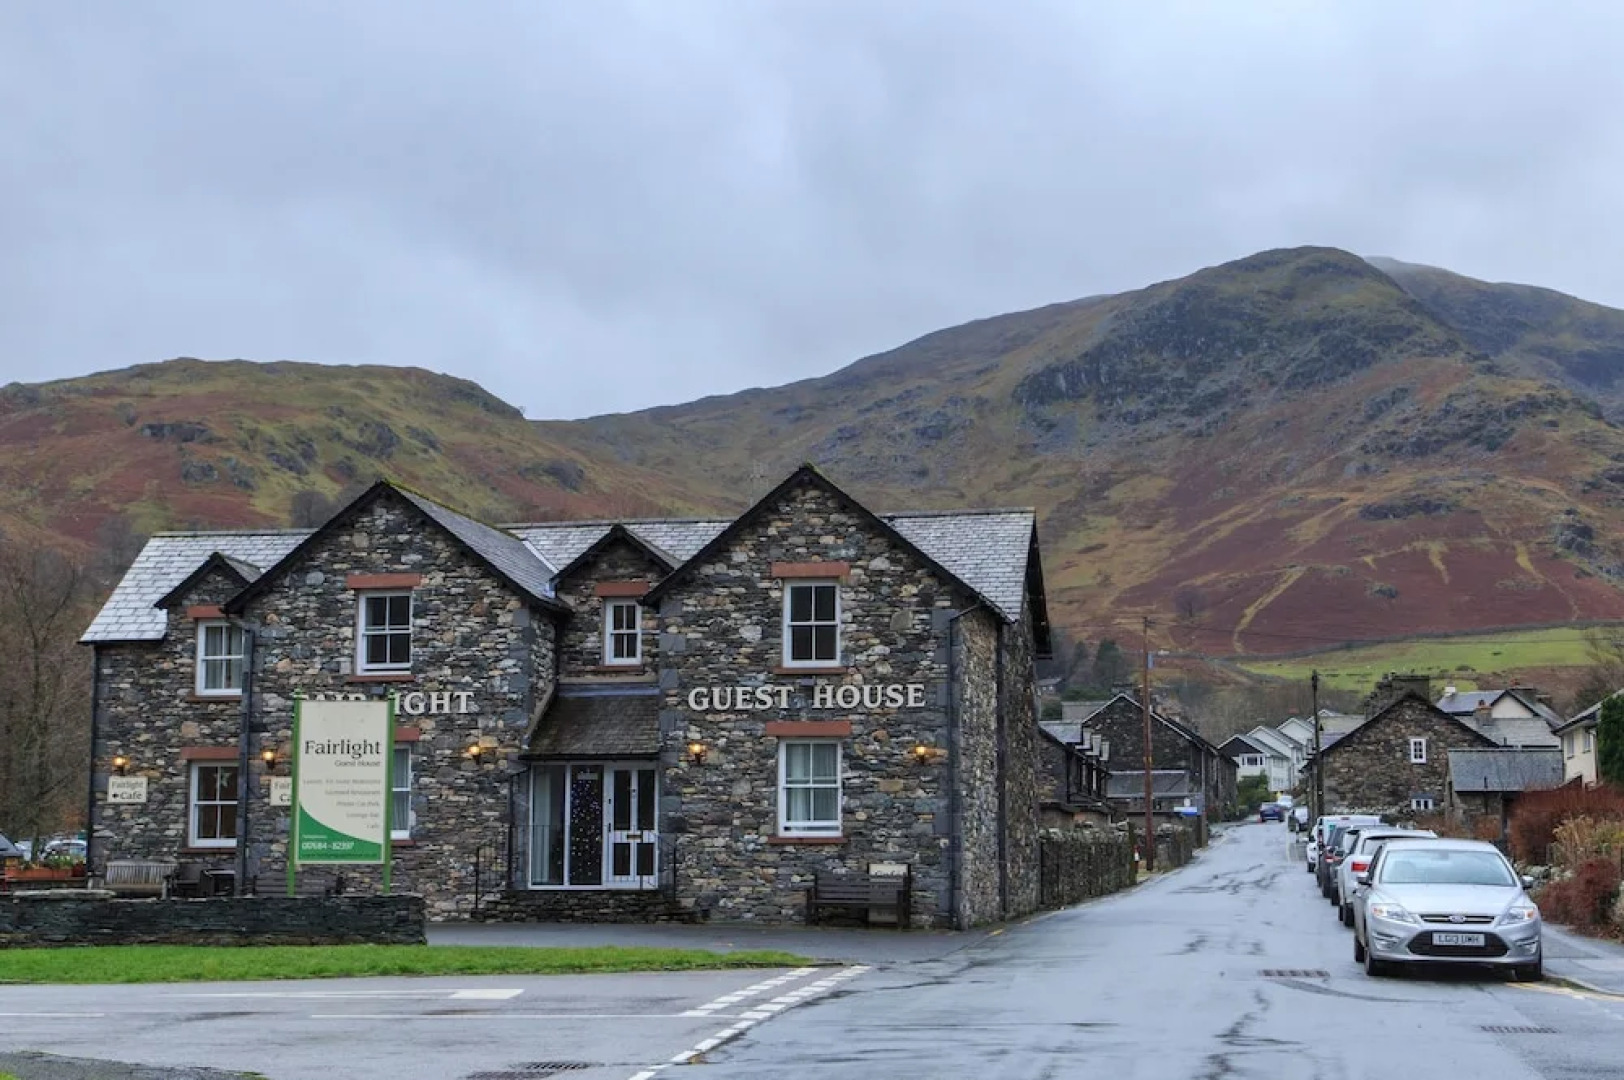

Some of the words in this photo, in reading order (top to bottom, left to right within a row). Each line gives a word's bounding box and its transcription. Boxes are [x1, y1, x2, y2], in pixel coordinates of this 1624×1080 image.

[688, 686, 794, 711] GUEST
[811, 684, 926, 710] HOUSE
[304, 738, 381, 759] Fairlight
